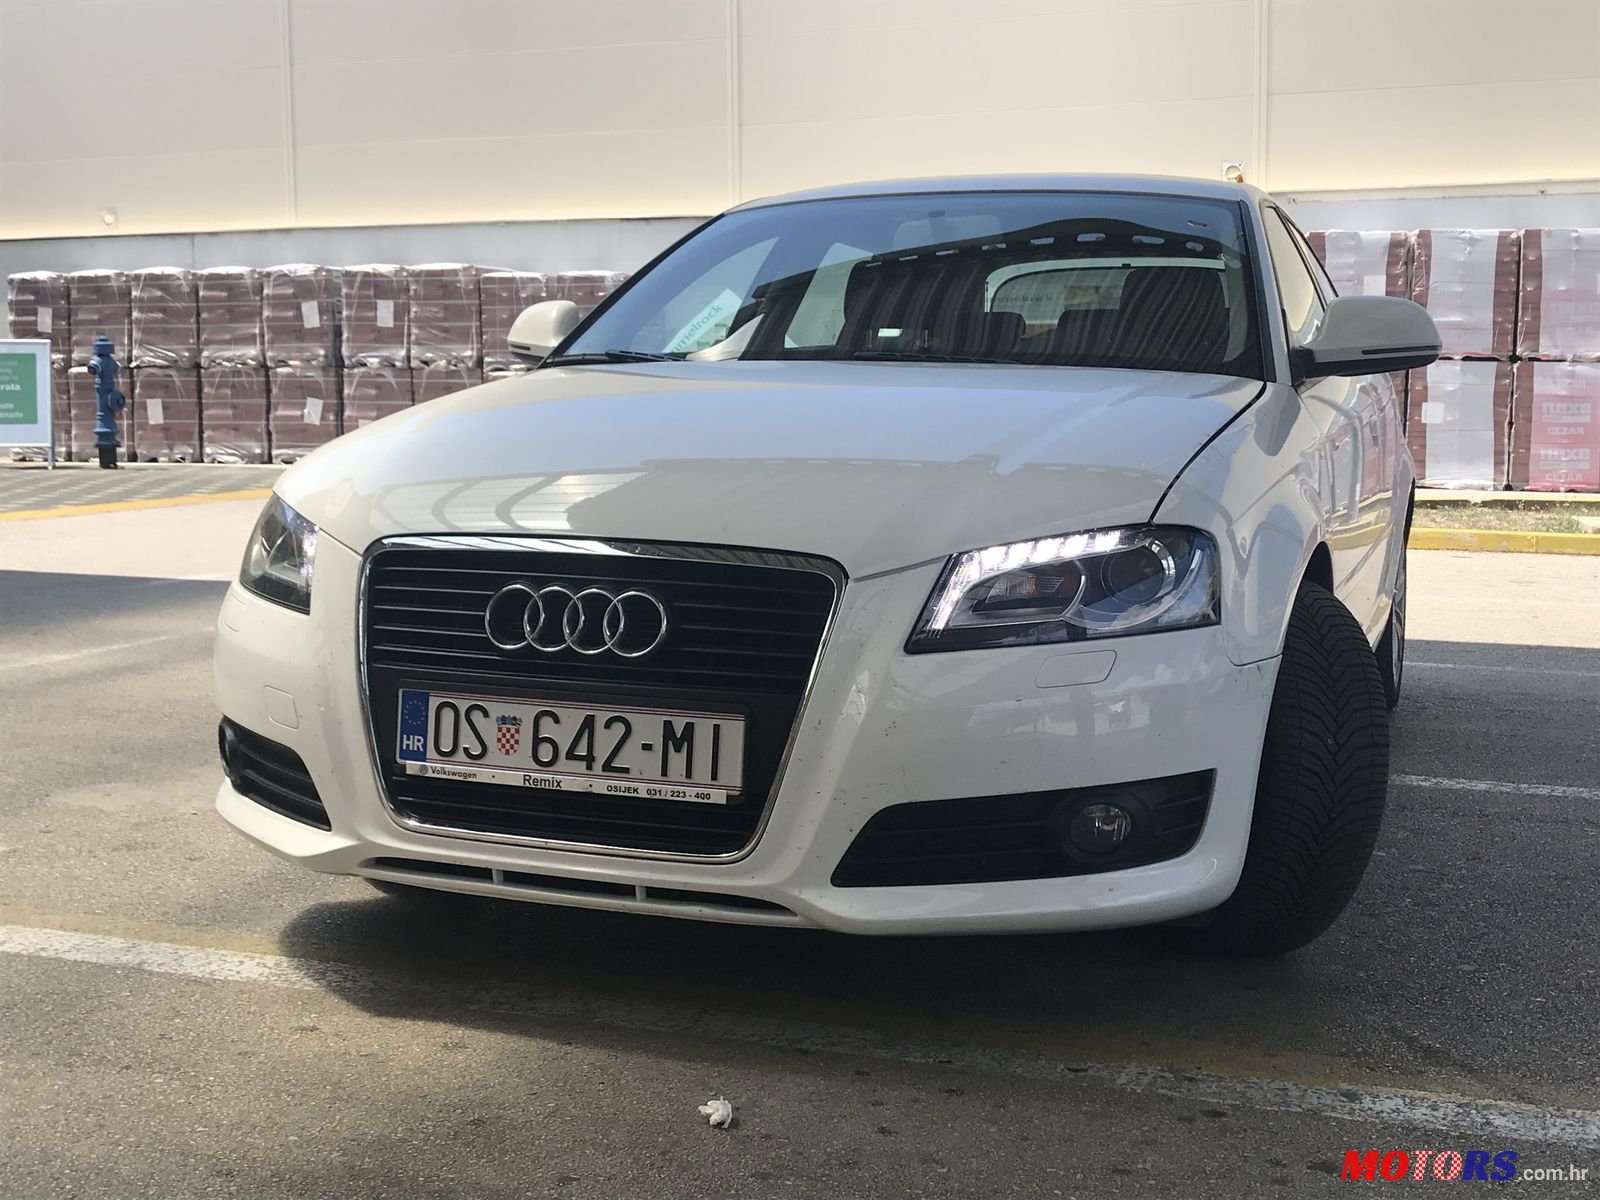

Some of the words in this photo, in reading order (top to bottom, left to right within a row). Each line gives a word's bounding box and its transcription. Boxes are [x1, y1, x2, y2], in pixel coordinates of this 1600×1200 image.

[402, 735, 424, 752] HR
[433, 700, 490, 761] OS
[530, 709, 721, 782] 642-MI
[430, 766, 478, 780] Volkswagen
[523, 774, 562, 789] Remix
[606, 784, 640, 795] OSIJEK
[646, 788, 662, 797] 031
[670, 790, 687, 799] 223
